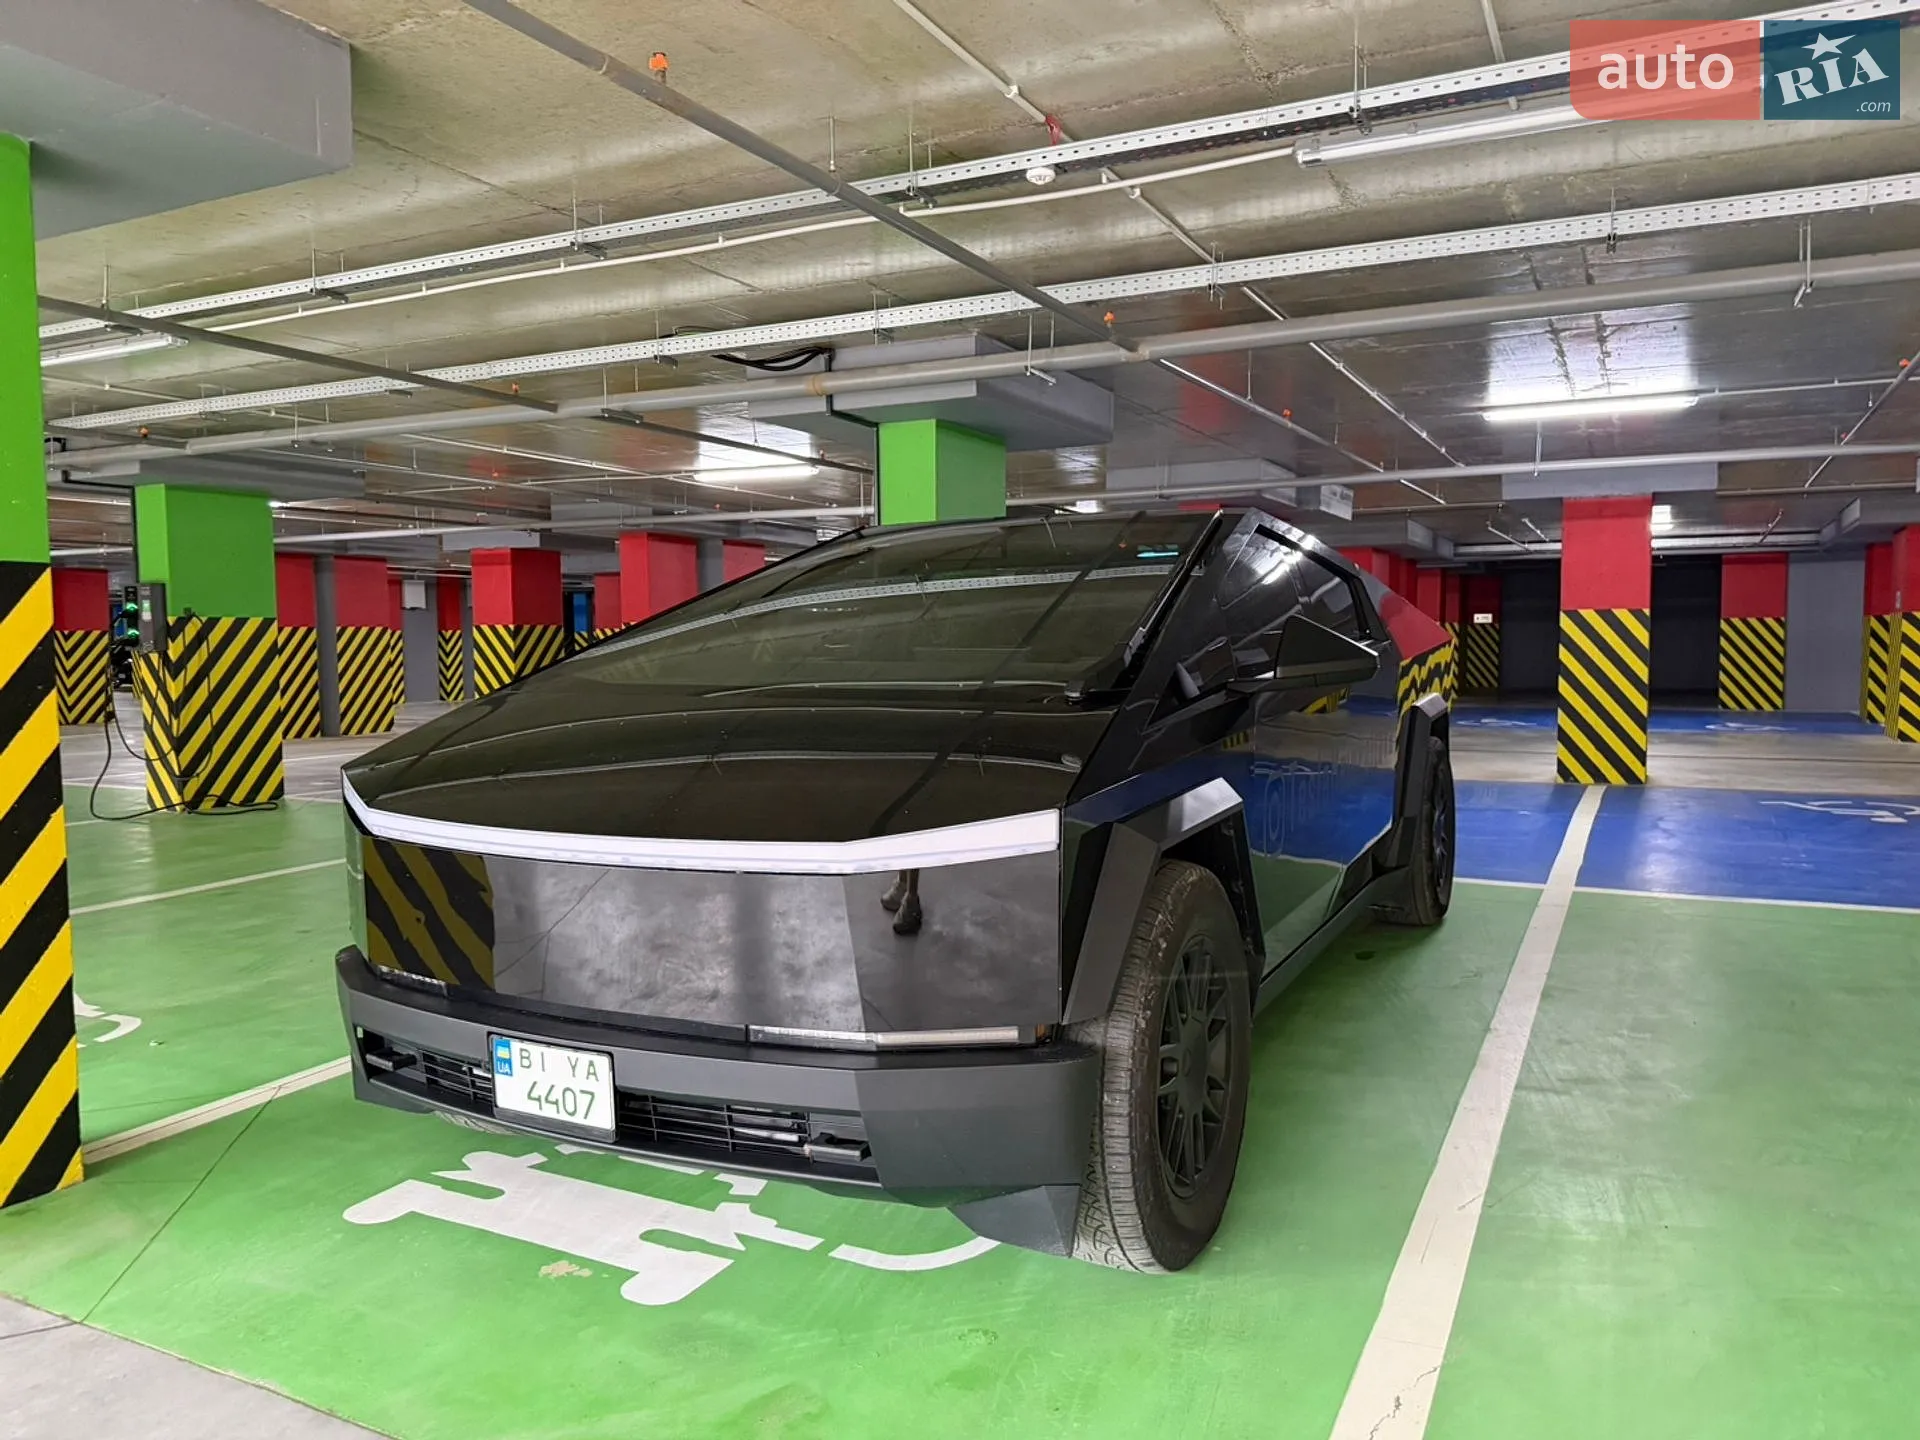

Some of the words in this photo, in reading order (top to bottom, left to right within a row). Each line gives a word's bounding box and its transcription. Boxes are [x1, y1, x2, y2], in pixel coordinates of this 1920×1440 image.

[497, 1060, 511, 1074] UA
[519, 1047, 546, 1073] BI
[567, 1056, 600, 1082] YA
[527, 1081, 596, 1120] 4407
